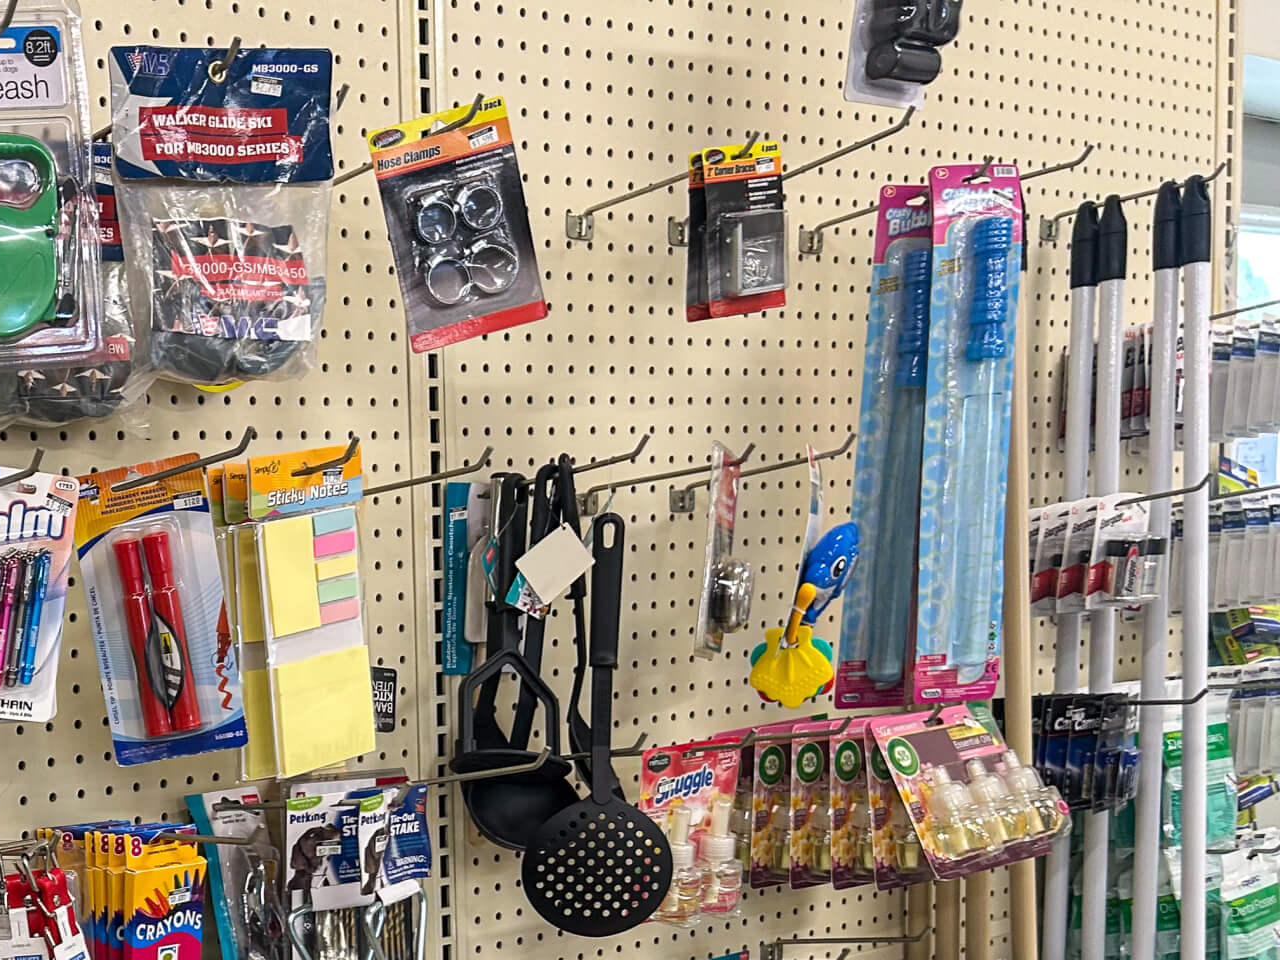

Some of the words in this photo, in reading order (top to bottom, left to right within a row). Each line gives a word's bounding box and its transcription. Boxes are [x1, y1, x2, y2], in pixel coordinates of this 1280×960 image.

[252, 64, 319, 73] MB3000-GS
[483, 99, 502, 111] pack
[152, 113, 207, 128] WALKER
[208, 115, 246, 129] GLIDE
[247, 115, 273, 129] SKI
[155, 142, 184, 155] FOR
[187, 141, 235, 157] MB3000
[237, 142, 290, 156] SERIES
[376, 155, 402, 171] Hose
[403, 145, 441, 165] Clamps
[267, 487, 306, 507] Sticky
[310, 482, 349, 500] Notes
[290, 812, 327, 825] Petking
[390, 812, 416, 824] Tie-Out
[390, 821, 420, 836] STAKE
[130, 837, 143, 856] 8
[135, 909, 203, 941] CRAYONS
